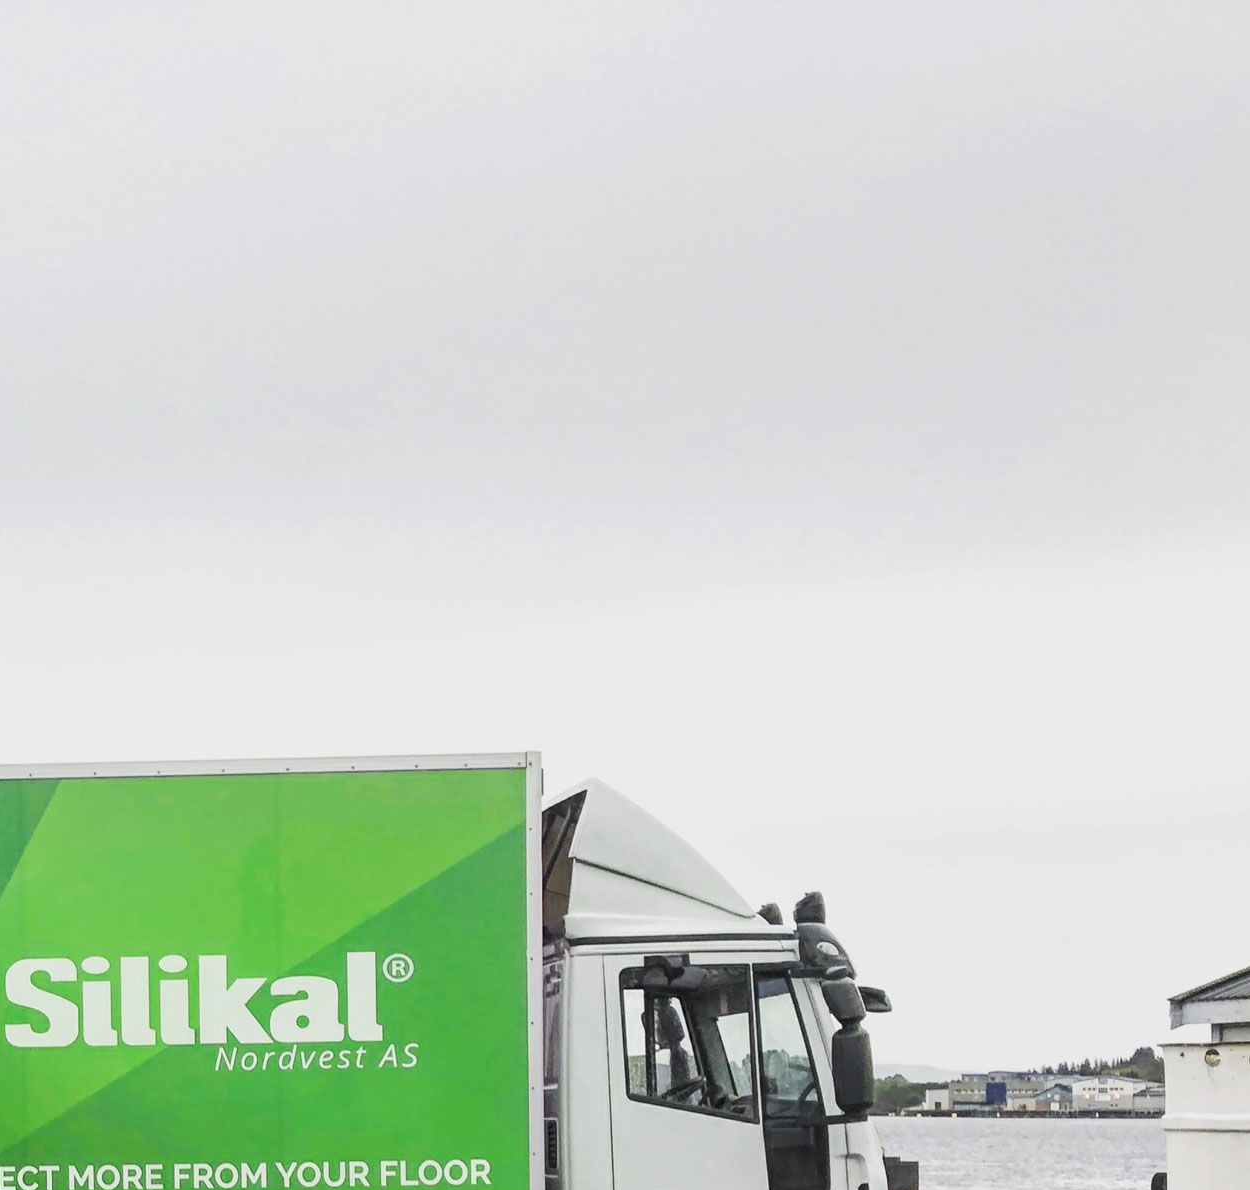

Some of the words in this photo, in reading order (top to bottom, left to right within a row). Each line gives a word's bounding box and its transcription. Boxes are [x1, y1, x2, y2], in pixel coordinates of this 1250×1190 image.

[214, 1045, 367, 1072] Nordvest
[379, 1043, 419, 1068] AS
[68, 1164, 164, 1190] MORE
[173, 1163, 268, 1189] FROM
[275, 1161, 370, 1188] YOUR
[380, 1159, 492, 1187] FLOOR
